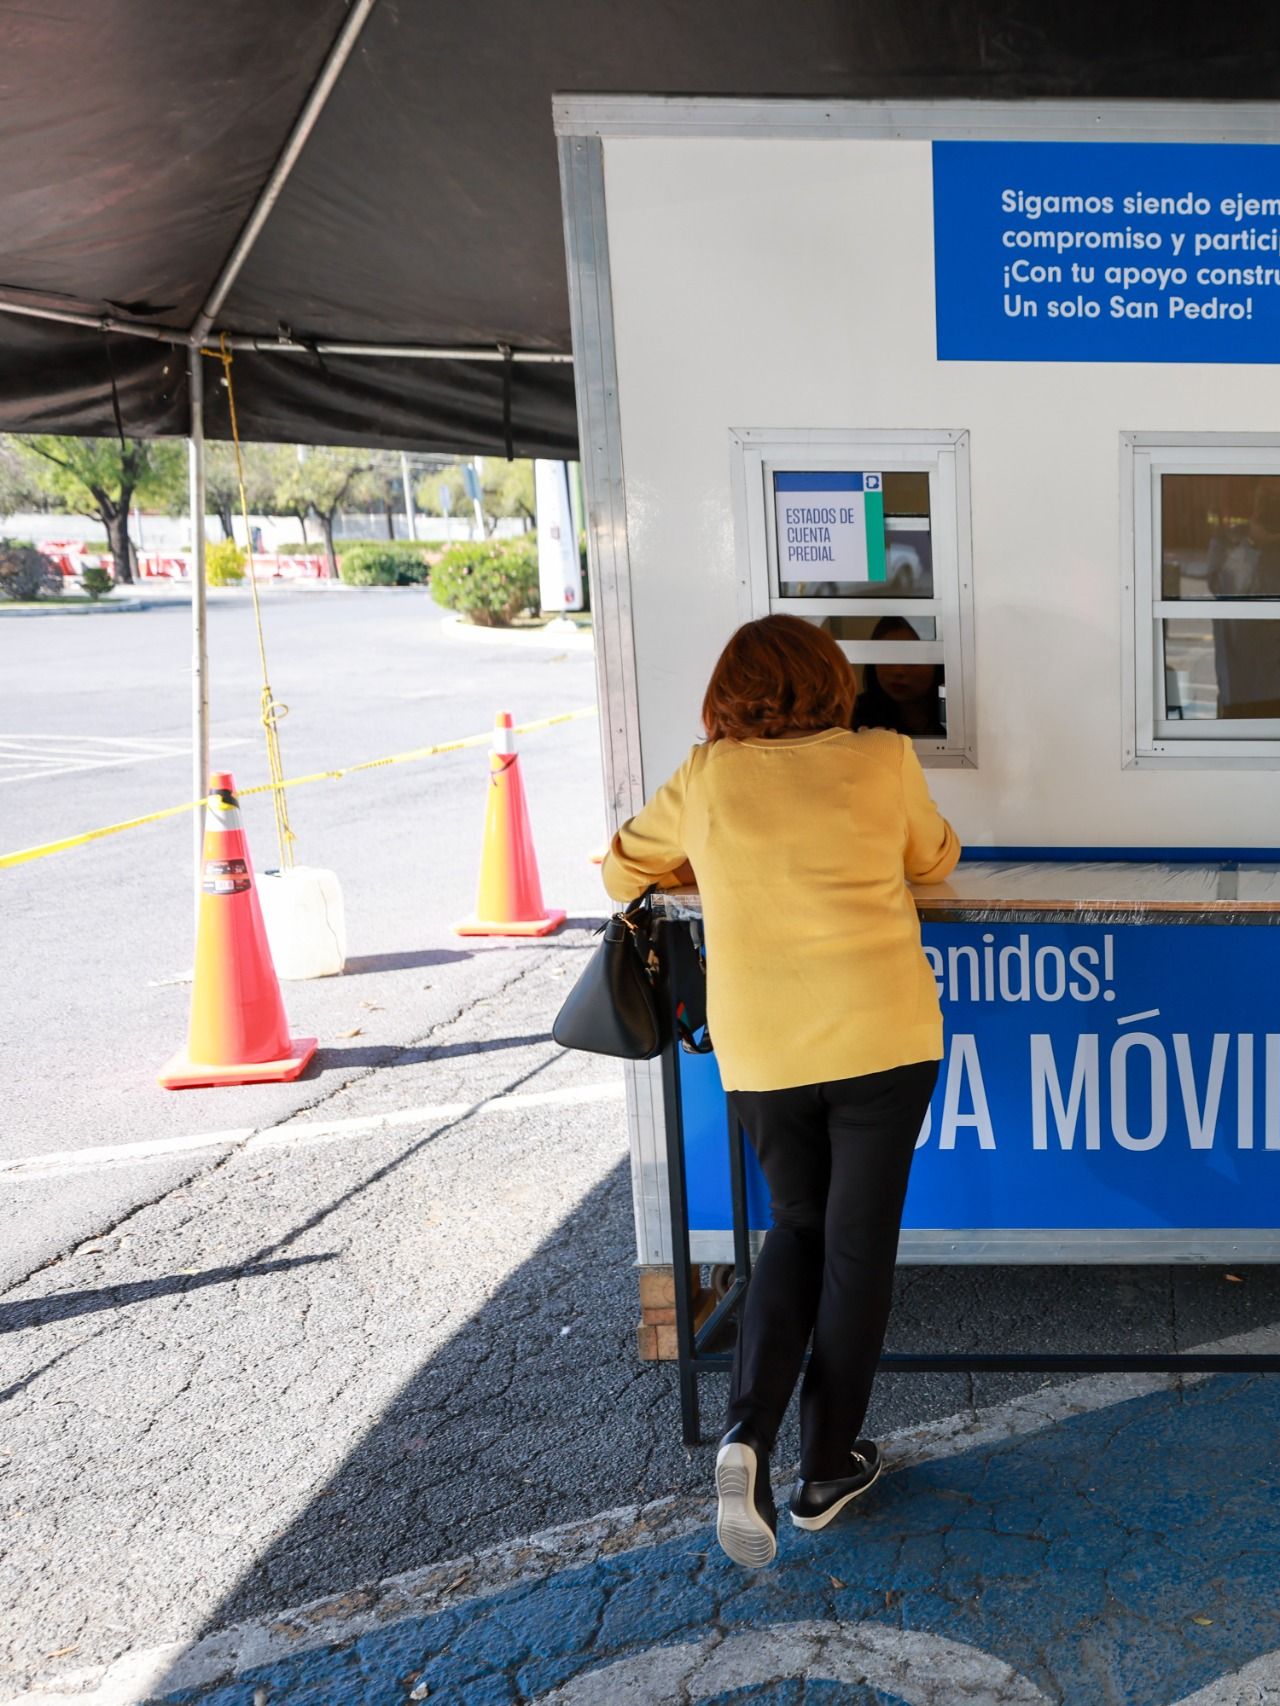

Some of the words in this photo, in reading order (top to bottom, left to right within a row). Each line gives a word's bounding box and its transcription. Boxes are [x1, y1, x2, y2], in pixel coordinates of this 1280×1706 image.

[1001, 189, 1114, 220] Sigamos
[1123, 191, 1211, 216] siendo
[1002, 226, 1162, 254] compromiso
[1170, 233, 1186, 256] y
[1004, 259, 1062, 289] ¡Con
[1071, 262, 1095, 284] tu
[1104, 266, 1188, 291] apoyo
[1004, 294, 1038, 317] Un
[1047, 295, 1101, 318] solo
[1110, 295, 1159, 319] San
[1169, 296, 1252, 320] Pedro!
[785, 507, 837, 525] ESTADOS
[839, 507, 855, 524] DE
[787, 527, 831, 543] CUENTA
[788, 545, 835, 562] PREDIAL
